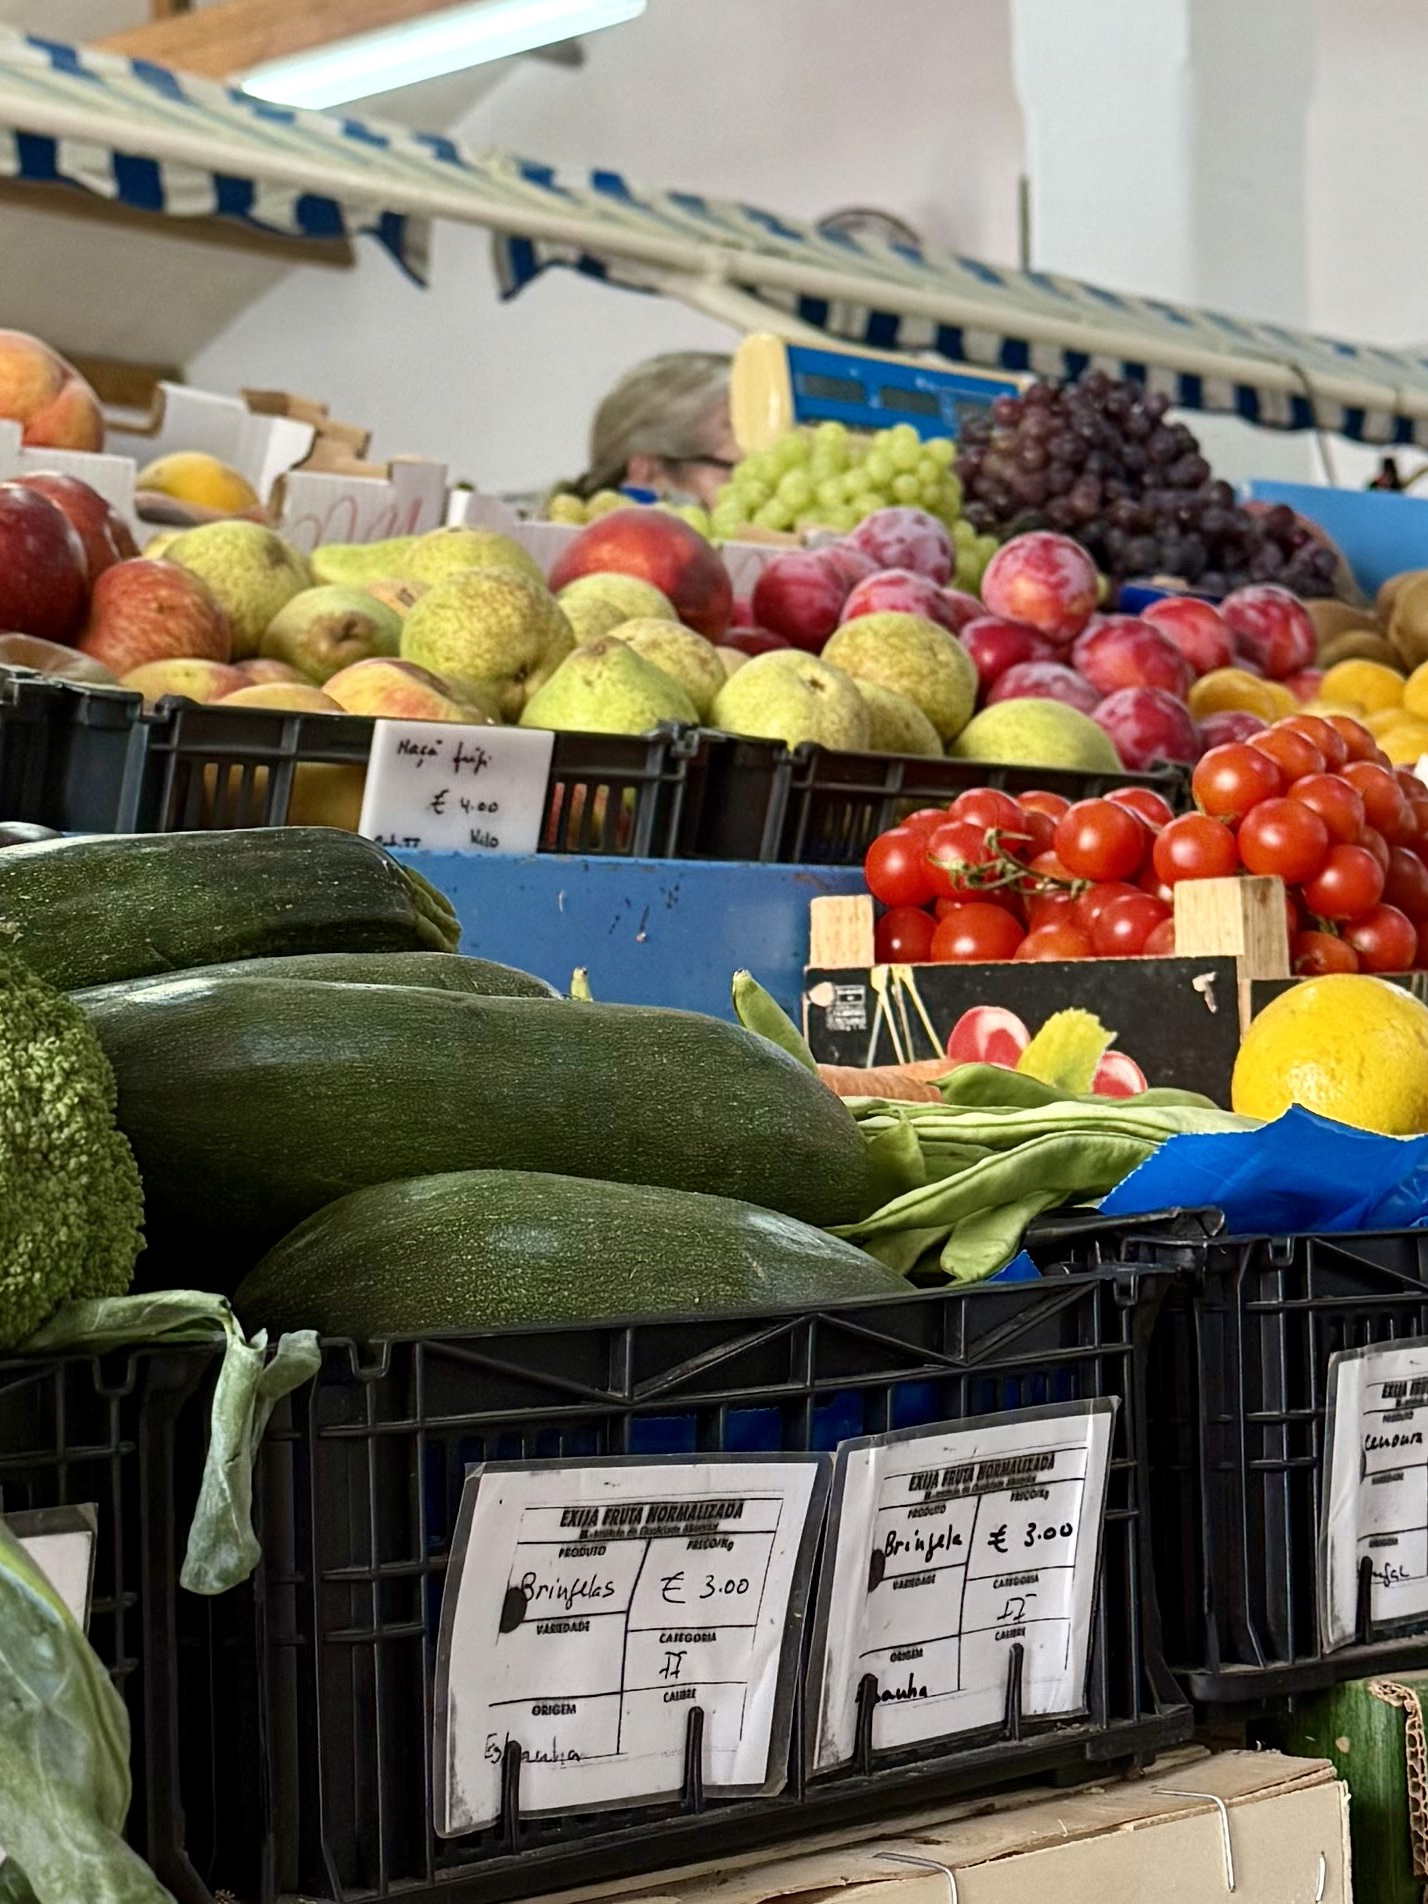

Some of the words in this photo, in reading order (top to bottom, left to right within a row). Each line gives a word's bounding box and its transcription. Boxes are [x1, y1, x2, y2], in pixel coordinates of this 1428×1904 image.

[430, 789, 449, 815] €
[559, 1507, 601, 1528] EXIJA
[601, 1504, 643, 1527] FRUTA
[645, 1499, 745, 1525] NORMALIZADA
[988, 1524, 1008, 1553] €
[1023, 1522, 1073, 1547] 3.00
[558, 1545, 607, 1558] PRODUTO
[660, 1571, 686, 1604] €
[699, 1574, 749, 1599] 3.00
[659, 1632, 717, 1644] CATEGORIA
[532, 1704, 577, 1716] ORIGEM
